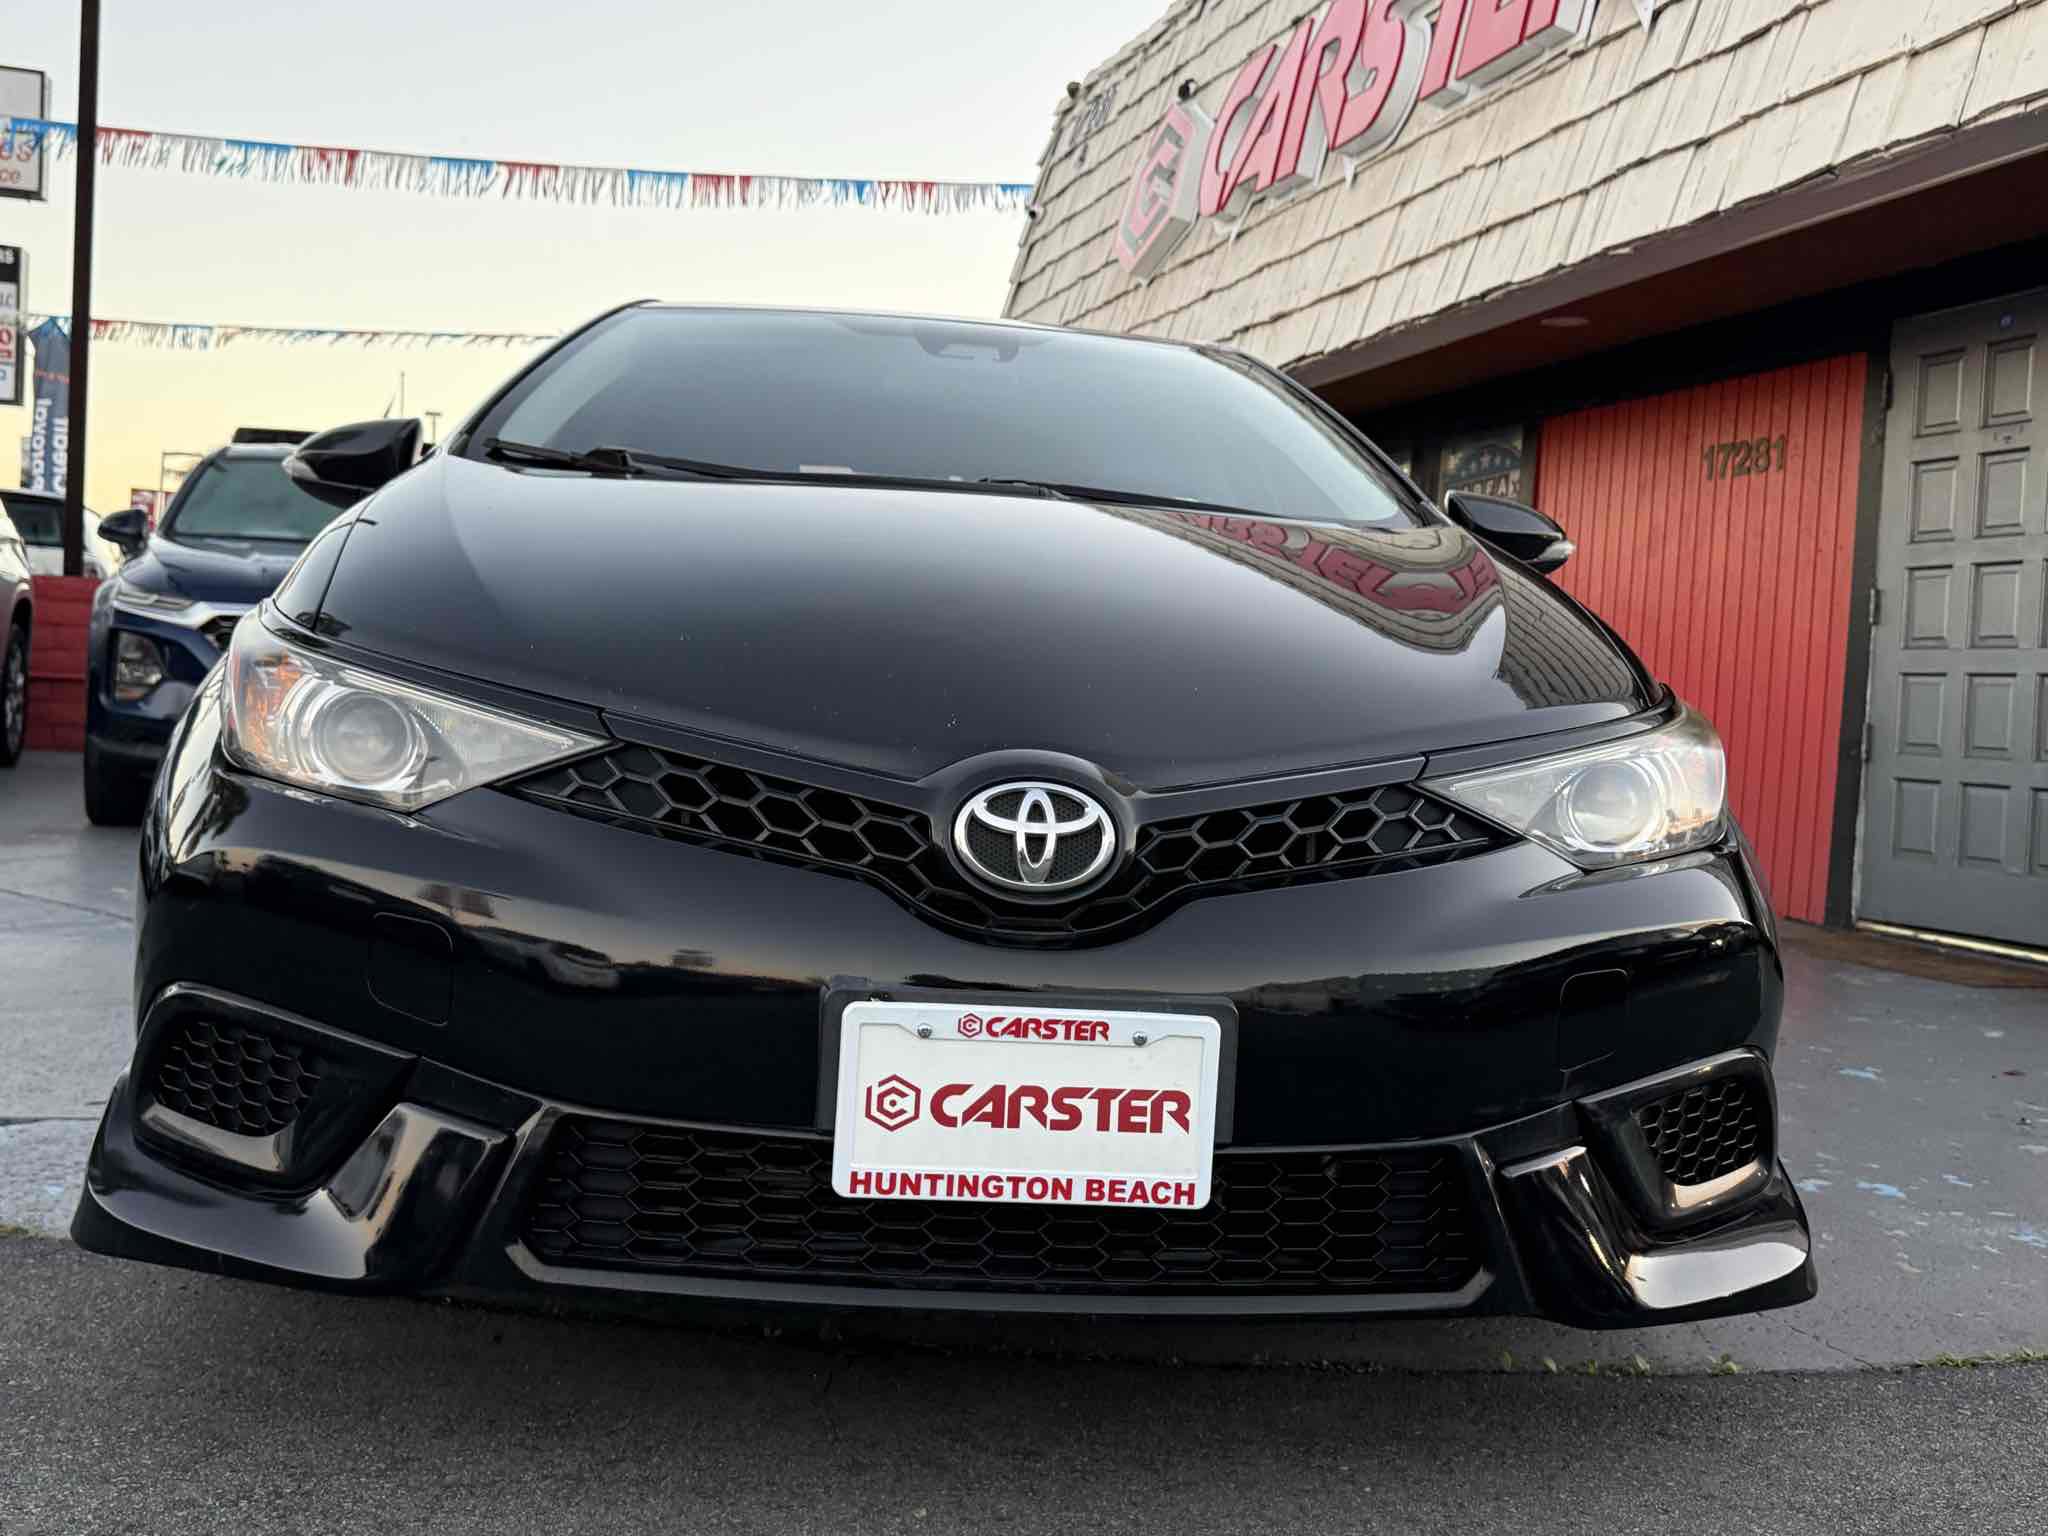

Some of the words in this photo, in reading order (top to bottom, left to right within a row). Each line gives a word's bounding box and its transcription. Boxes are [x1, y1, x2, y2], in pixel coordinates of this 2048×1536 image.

[1200, 0, 1559, 217] CARS
[1704, 434, 1786, 480] 17281
[985, 1015, 1110, 1041] CARSTER
[929, 1083, 1192, 1136] CARSTER
[849, 1171, 1073, 1201] HUNTINGTON
[1085, 1178, 1197, 1206] BEACH
